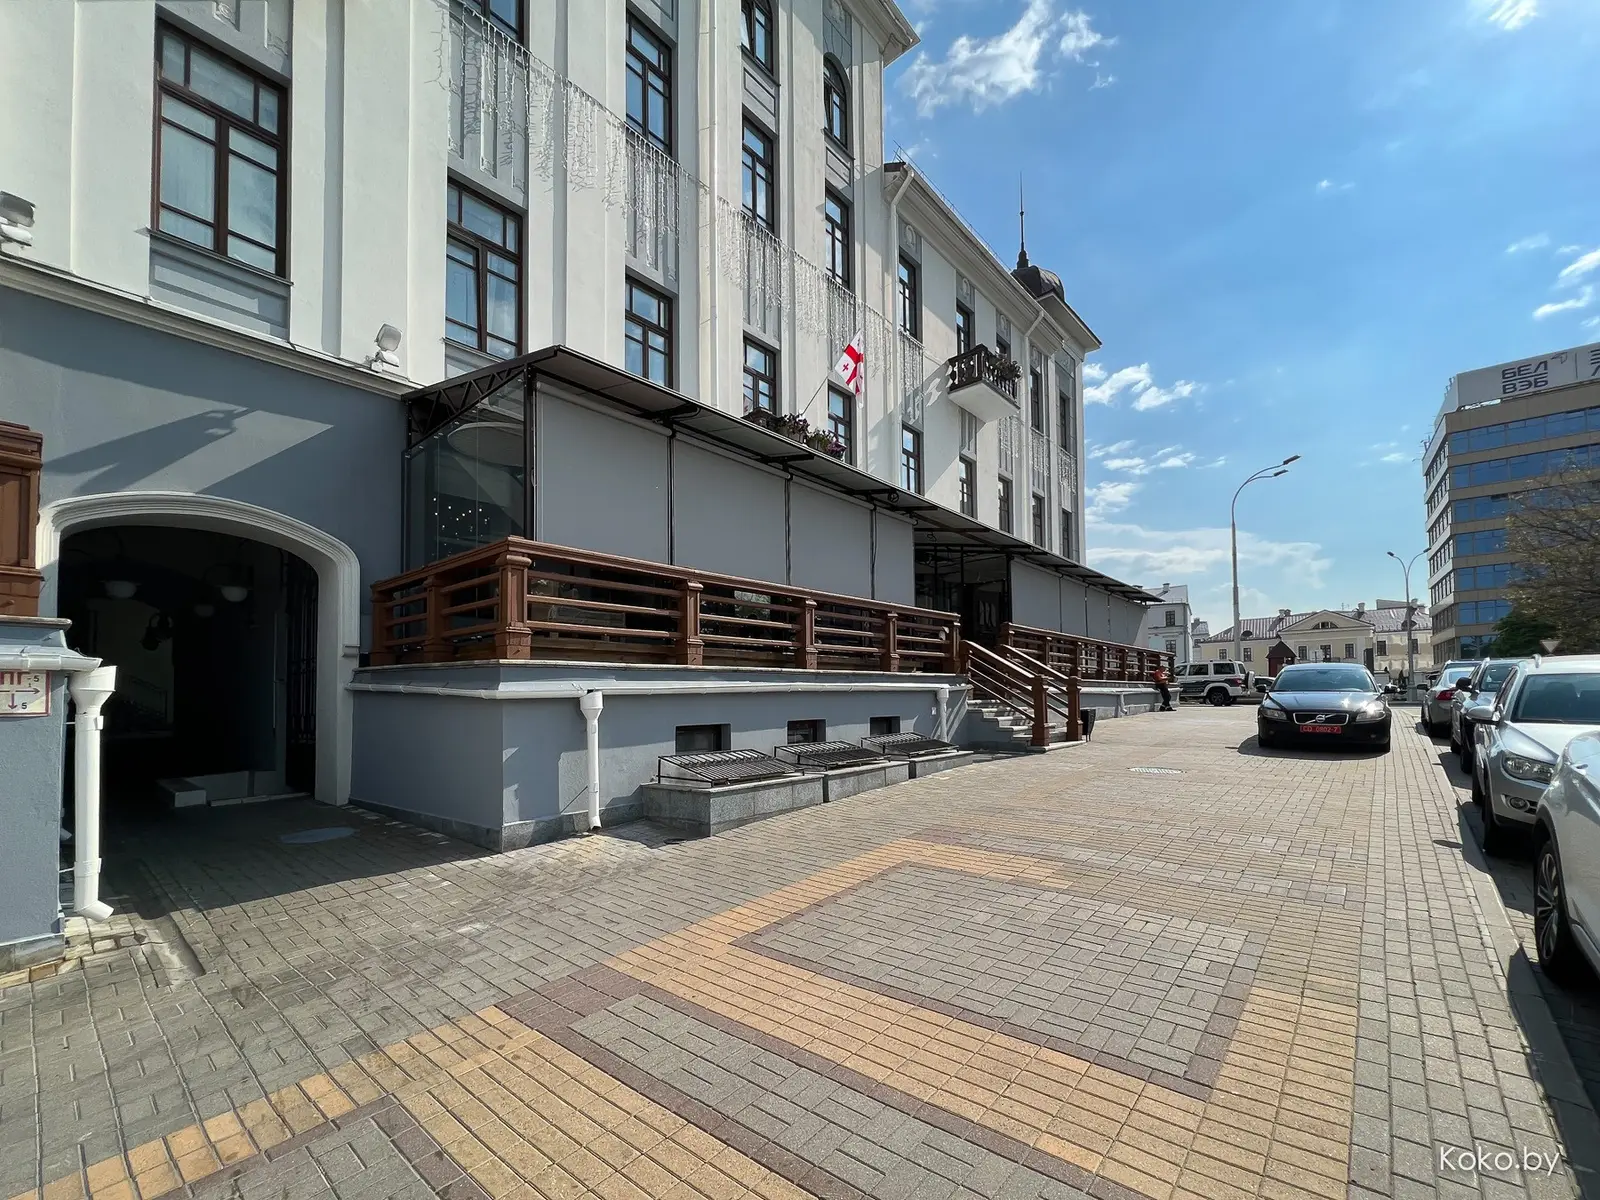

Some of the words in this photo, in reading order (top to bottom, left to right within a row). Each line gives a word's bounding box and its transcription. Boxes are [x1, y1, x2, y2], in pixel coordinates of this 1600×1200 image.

[1501, 360, 1548, 379] БЕЛ
[1502, 376, 1549, 394] ВЭБ
[21, 701, 28, 710] 5
